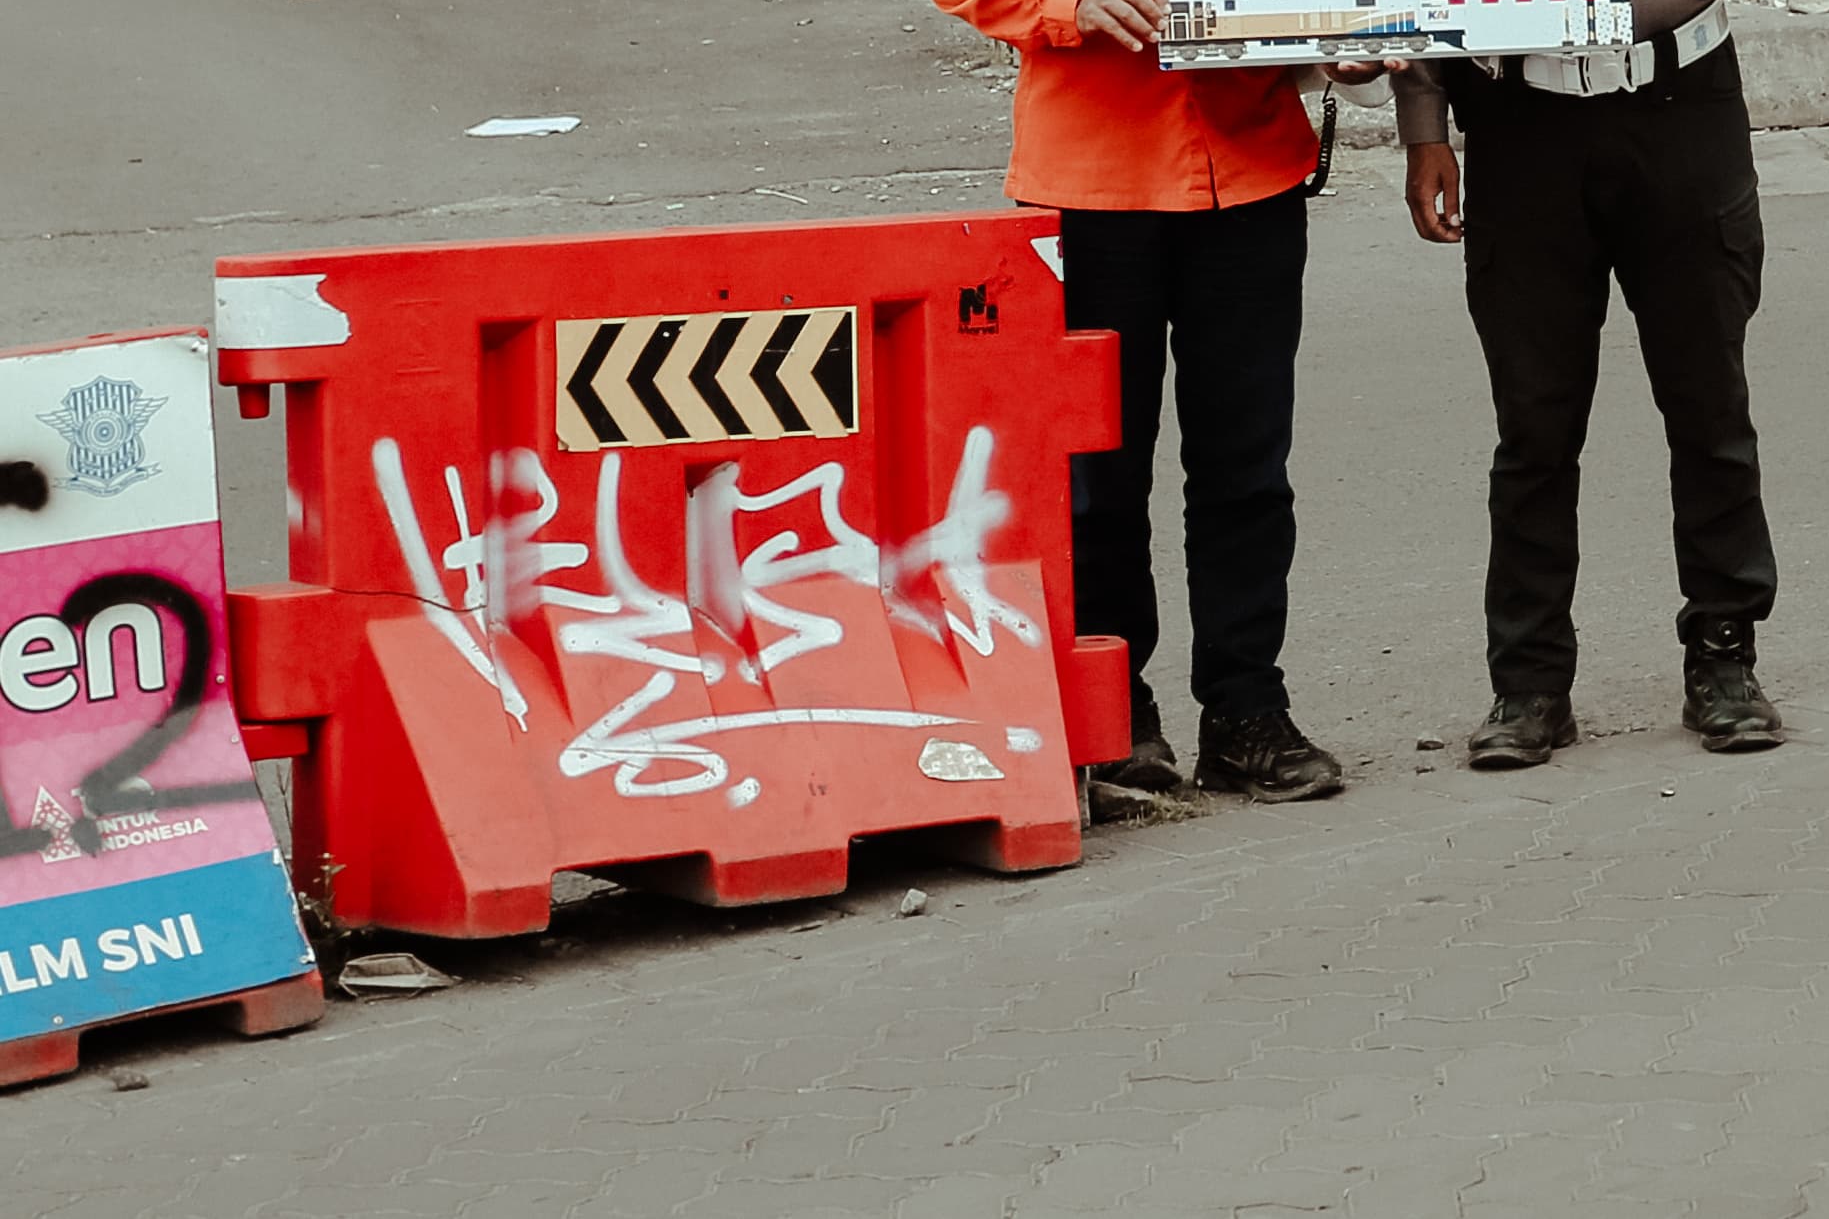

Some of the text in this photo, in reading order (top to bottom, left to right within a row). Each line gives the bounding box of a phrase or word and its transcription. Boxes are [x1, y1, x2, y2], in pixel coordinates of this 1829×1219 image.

[95, 811, 161, 837] NTUK
[98, 817, 209, 854] NDONESIA
[0, 912, 204, 996] LM SNI
